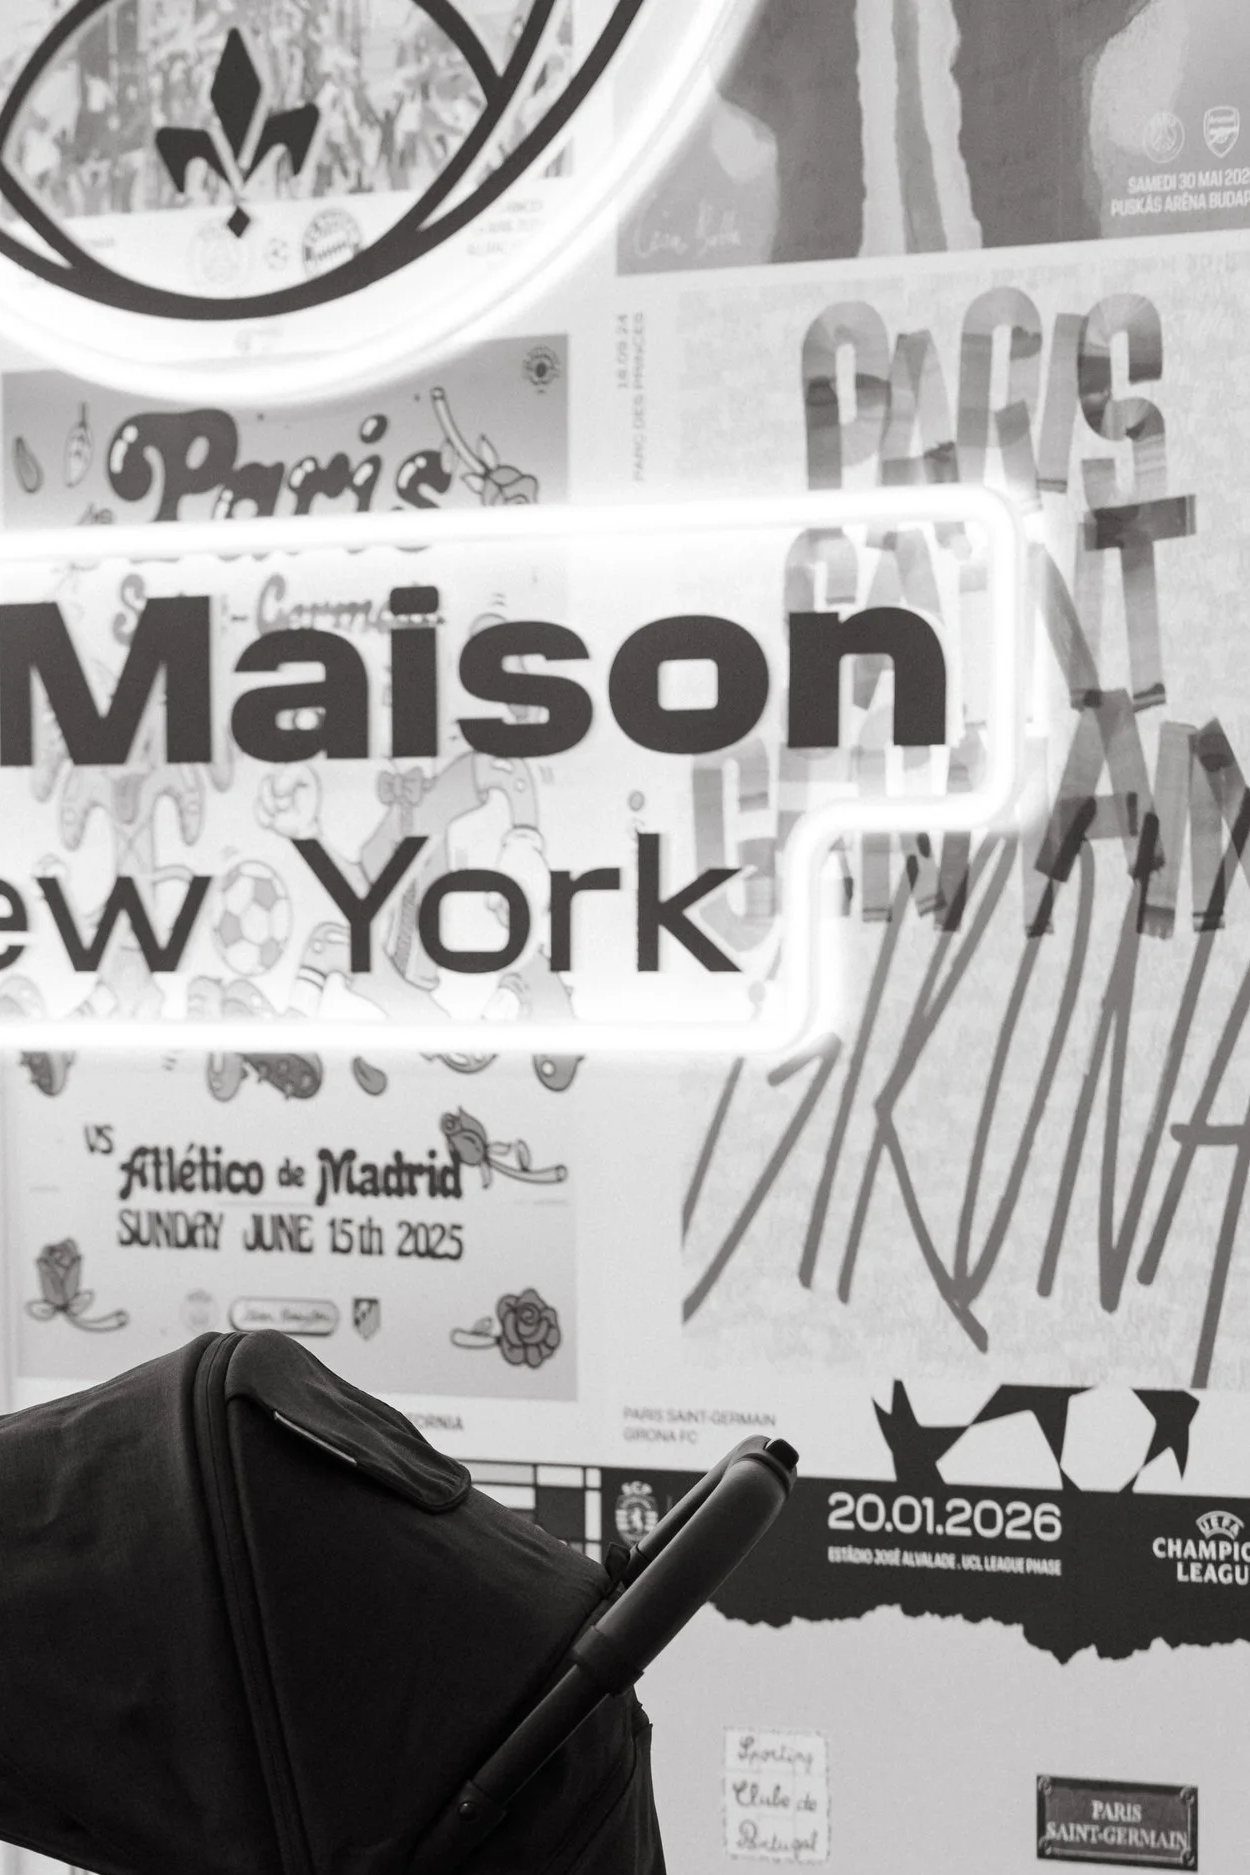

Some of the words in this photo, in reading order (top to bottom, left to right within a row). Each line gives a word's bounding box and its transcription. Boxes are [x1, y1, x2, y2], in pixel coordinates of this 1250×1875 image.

[1127, 174, 1177, 194] SAMEDI
[1178, 171, 1197, 191] 30
[1197, 169, 1224, 188] MAI
[291, 832, 743, 974] York
[84, 1123, 115, 1155] VS
[118, 1142, 264, 1200] Atlético
[278, 1158, 306, 1188] de
[315, 1147, 464, 1207] Madrid
[243, 1213, 315, 1255] JUNE
[396, 1220, 465, 1262] 2025
[622, 1406, 664, 1422] PARIS
[666, 1408, 777, 1427] SAINT-GERMAIN
[622, 1426, 676, 1443] GIRONA
[679, 1429, 699, 1445] FC
[827, 1491, 1063, 1542] 20.01.2026
[1195, 1510, 1245, 1540] UEFA
[902, 1551, 956, 1570] ALVALADE
[961, 1554, 984, 1572] UCL
[984, 1556, 1025, 1573] LEAGUE
[1026, 1558, 1062, 1576] PHASE
[1091, 1799, 1143, 1823] PARIS
[1046, 1821, 1188, 1850] SAINT-GERMAIN
